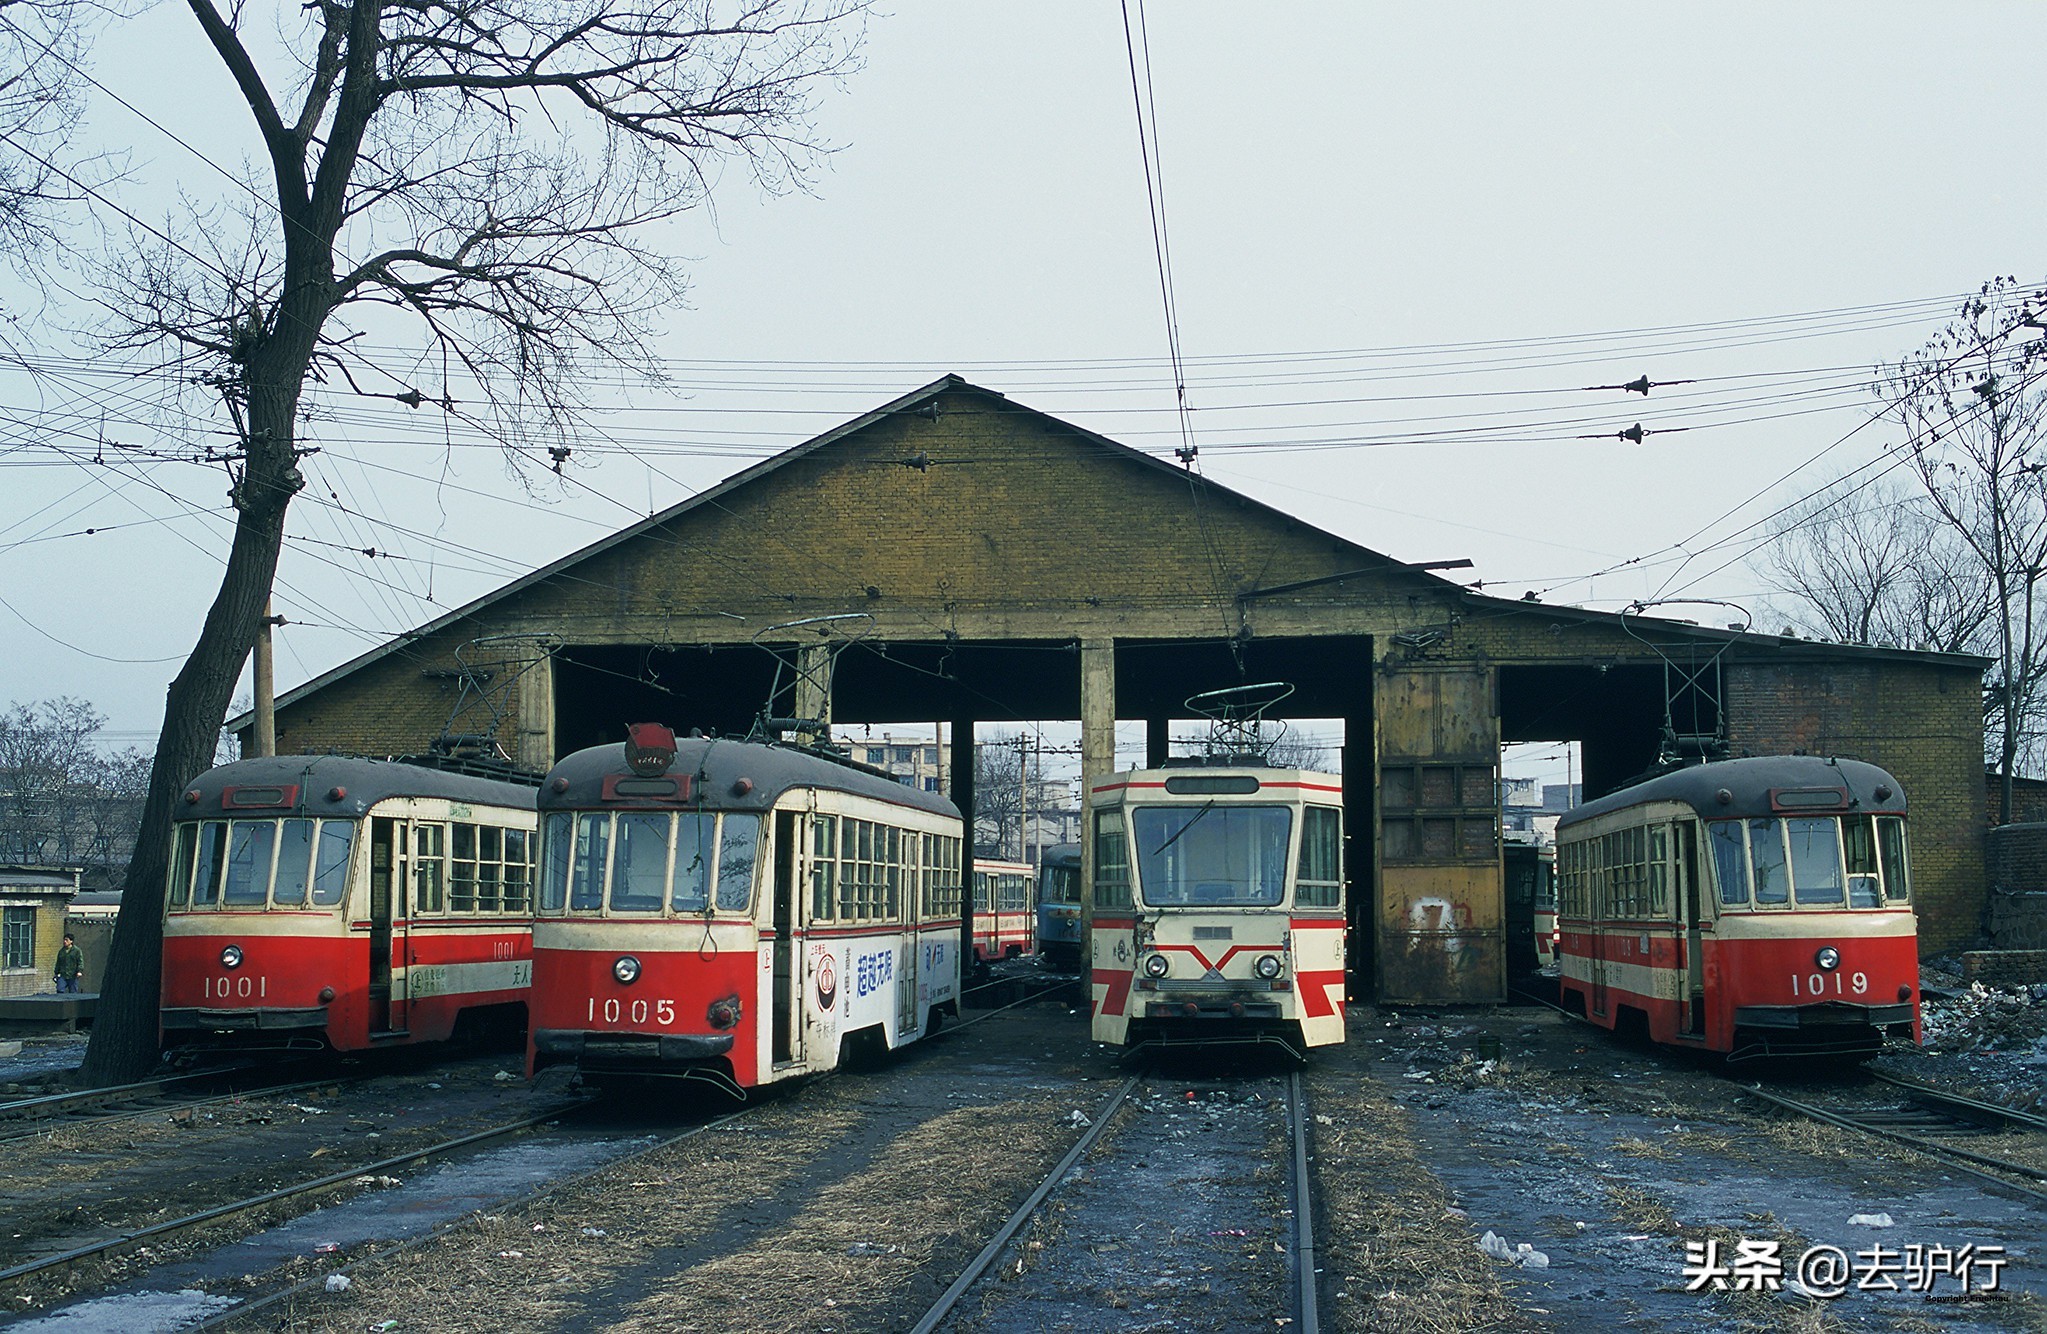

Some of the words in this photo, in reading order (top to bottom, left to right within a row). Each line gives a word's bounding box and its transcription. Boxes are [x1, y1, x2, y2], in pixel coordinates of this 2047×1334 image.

[494, 941, 513, 959] 1001
[857, 949, 893, 998] 超越无限
[1792, 971, 1868, 997] 1019
[205, 976, 266, 998] 1001
[588, 997, 675, 1026] 1005
